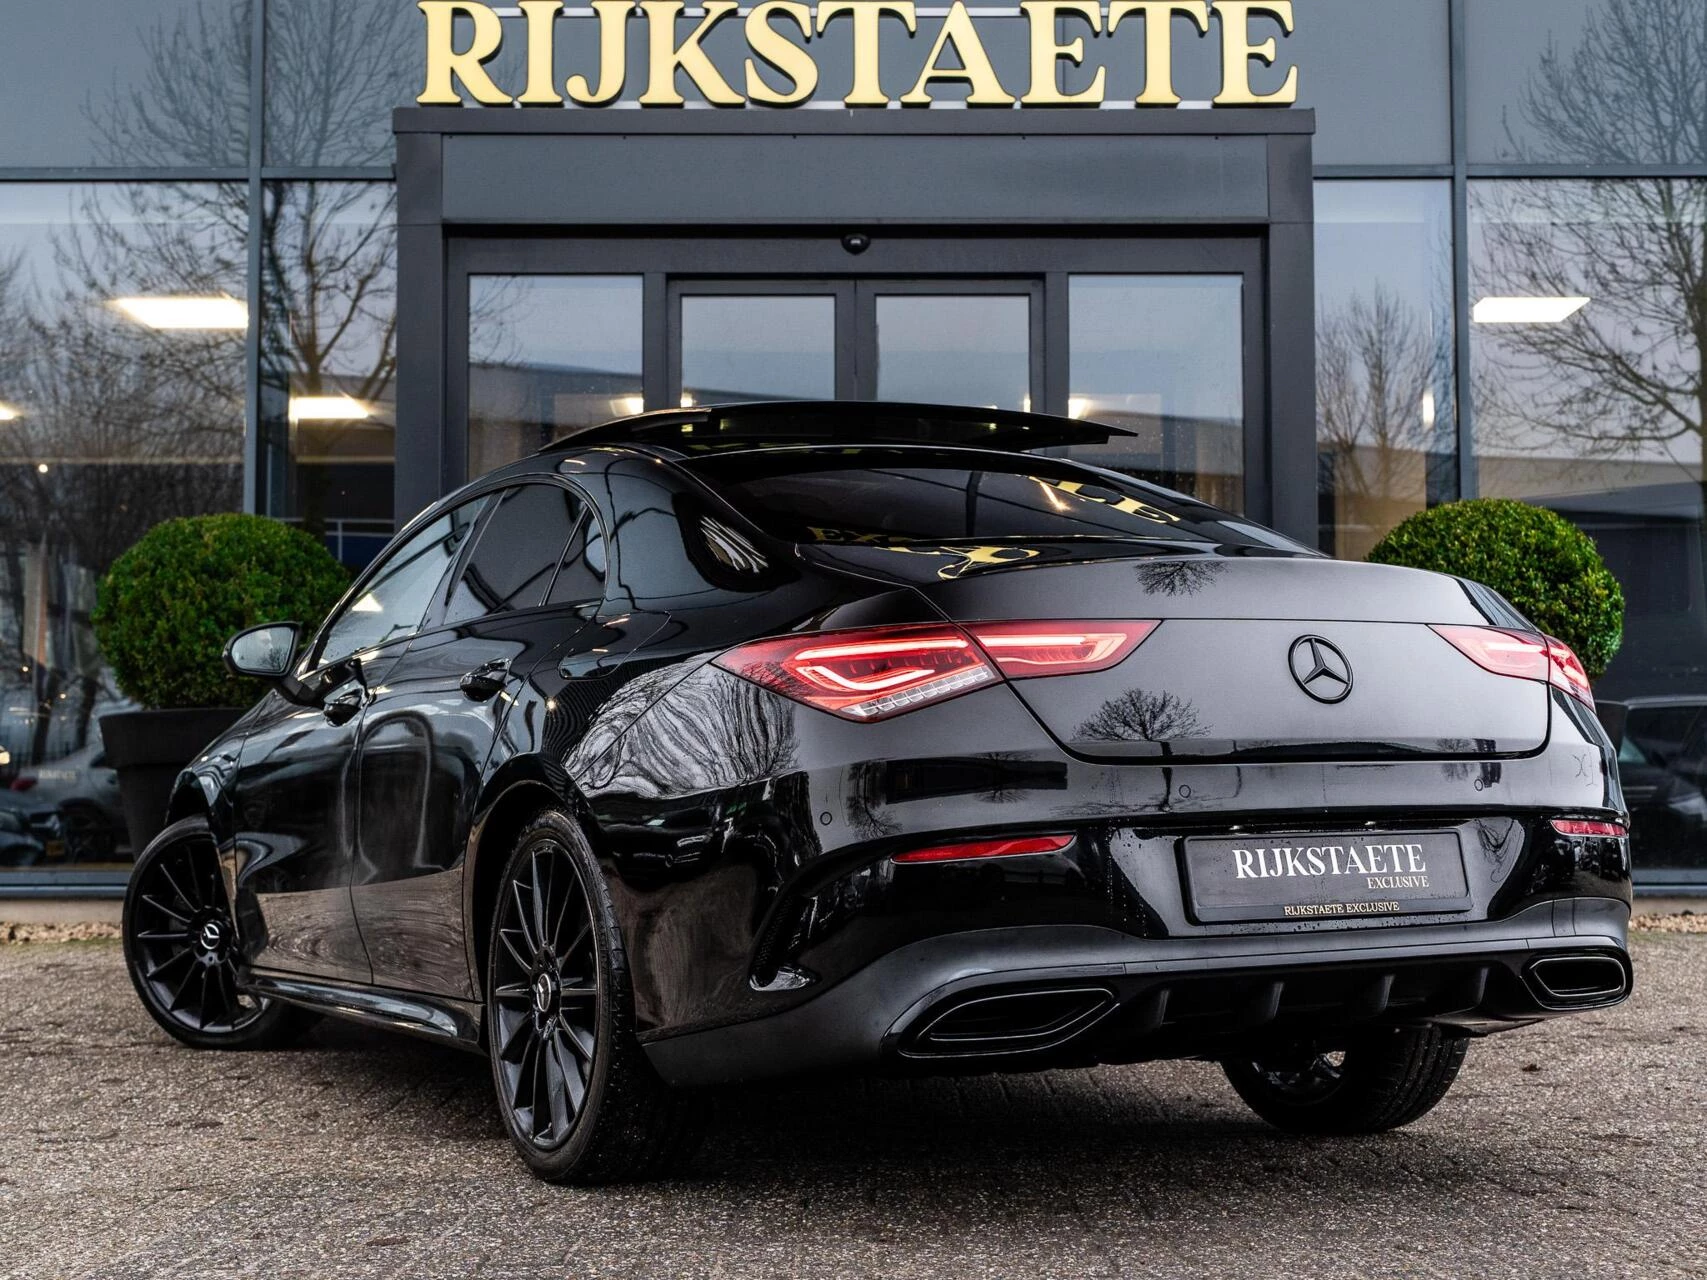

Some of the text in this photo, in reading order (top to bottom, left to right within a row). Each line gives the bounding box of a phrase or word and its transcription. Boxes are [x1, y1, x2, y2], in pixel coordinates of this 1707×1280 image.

[416, 0, 1299, 106] RIJKSTAETE
[1232, 844, 1426, 878] RIJKSTAETE
[1367, 876, 1430, 889] EXCLUSIVE
[1284, 901, 1400, 916] RIJKSTAETE EXCLUSIVE
